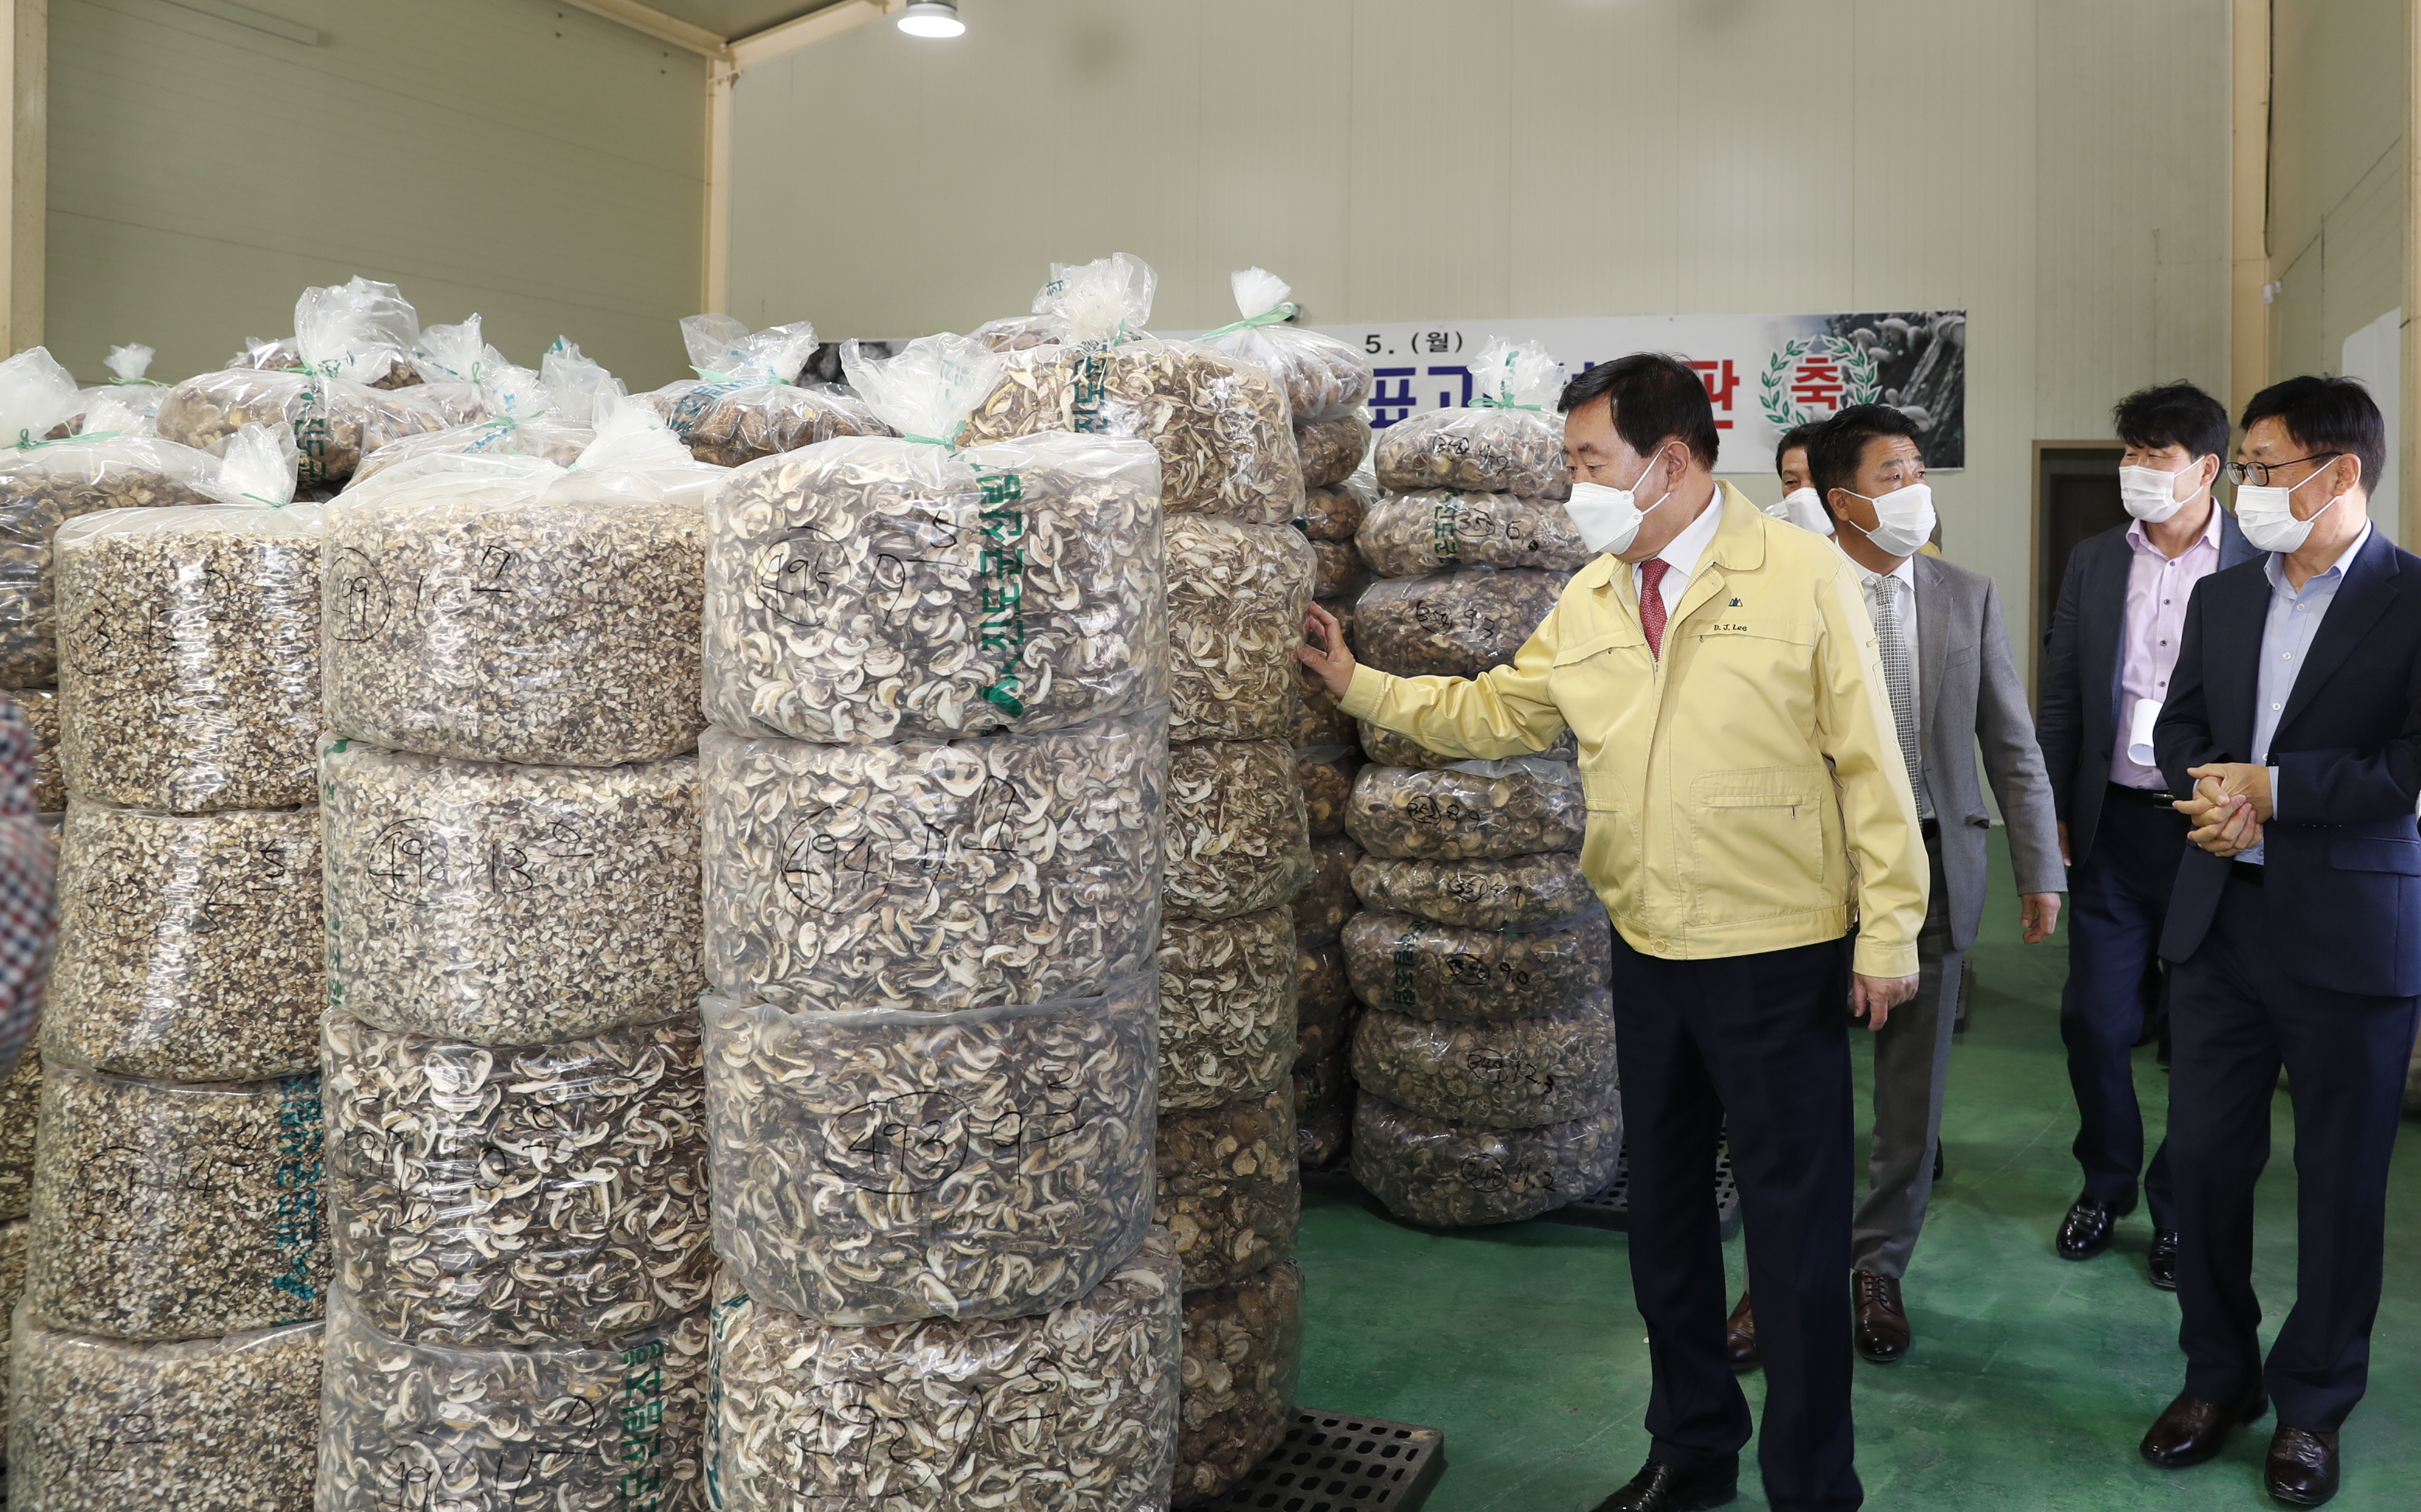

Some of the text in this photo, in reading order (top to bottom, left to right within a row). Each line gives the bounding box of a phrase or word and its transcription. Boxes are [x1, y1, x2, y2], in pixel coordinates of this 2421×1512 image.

[1410, 331, 1462, 355] (월)
[1791, 357, 1843, 411] 축
[761, 552, 836, 614] 495
[975, 463, 1024, 652] 진도군산림
[1733, 623, 1748, 632] Lee
[368, 831, 448, 891] 498
[784, 833, 877, 900] 494
[848, 1119, 947, 1175] 493
